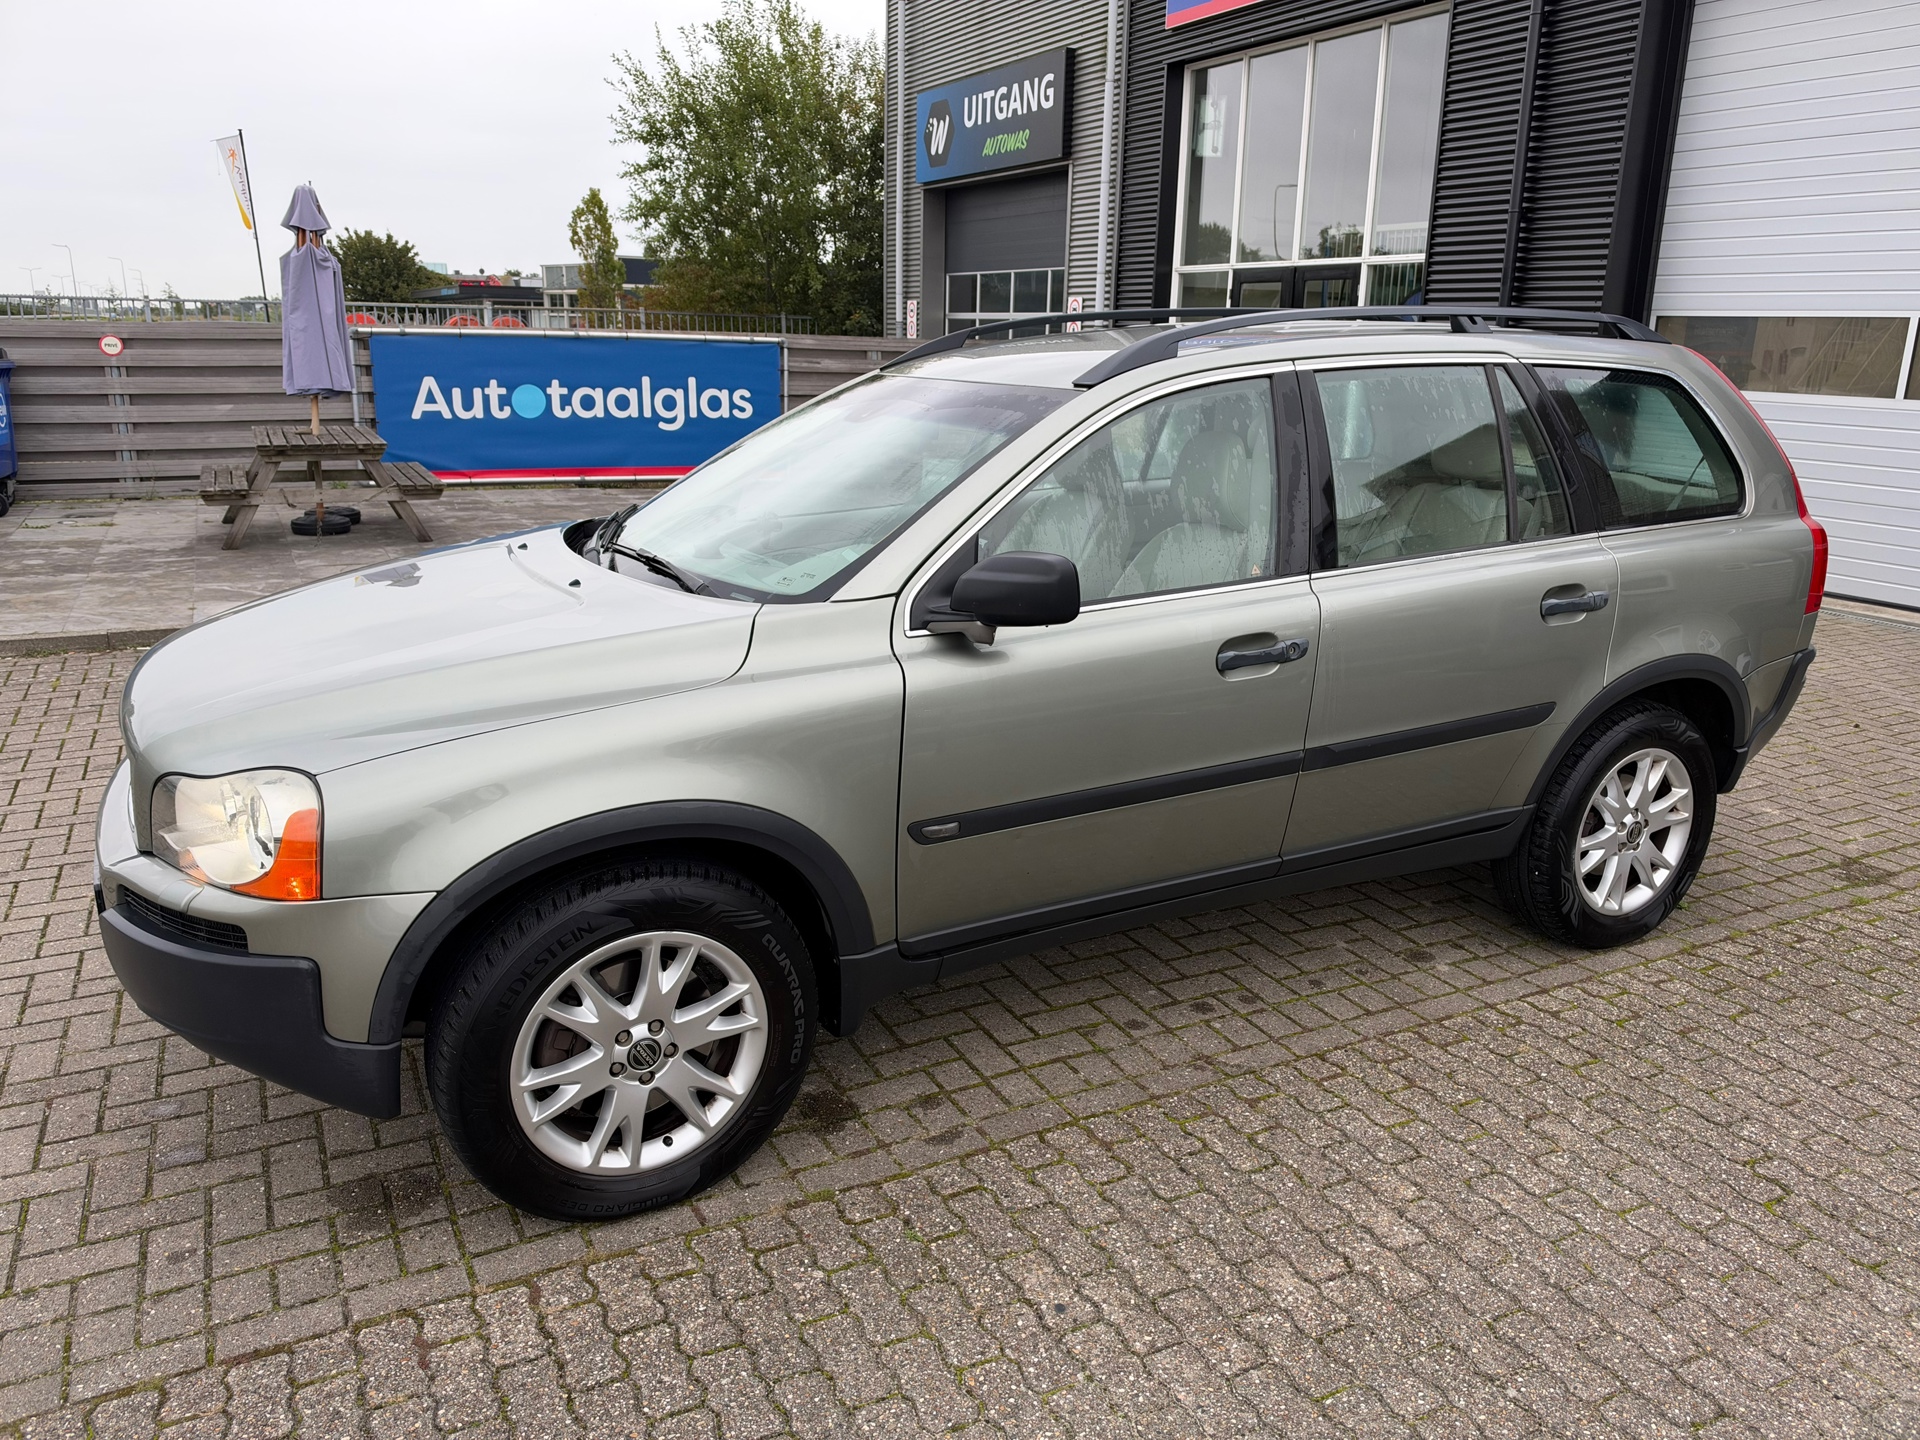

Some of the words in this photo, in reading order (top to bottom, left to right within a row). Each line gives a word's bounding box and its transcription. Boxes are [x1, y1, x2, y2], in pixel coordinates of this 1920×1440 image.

[963, 73, 1055, 128] UITGANG
[982, 128, 1030, 157] AUTOWAS
[411, 376, 753, 431] Autotaalglas
[761, 933, 805, 1017] QUATRAC
[790, 1017, 805, 1065] PRO
[636, 1044, 654, 1065] VOLVO
